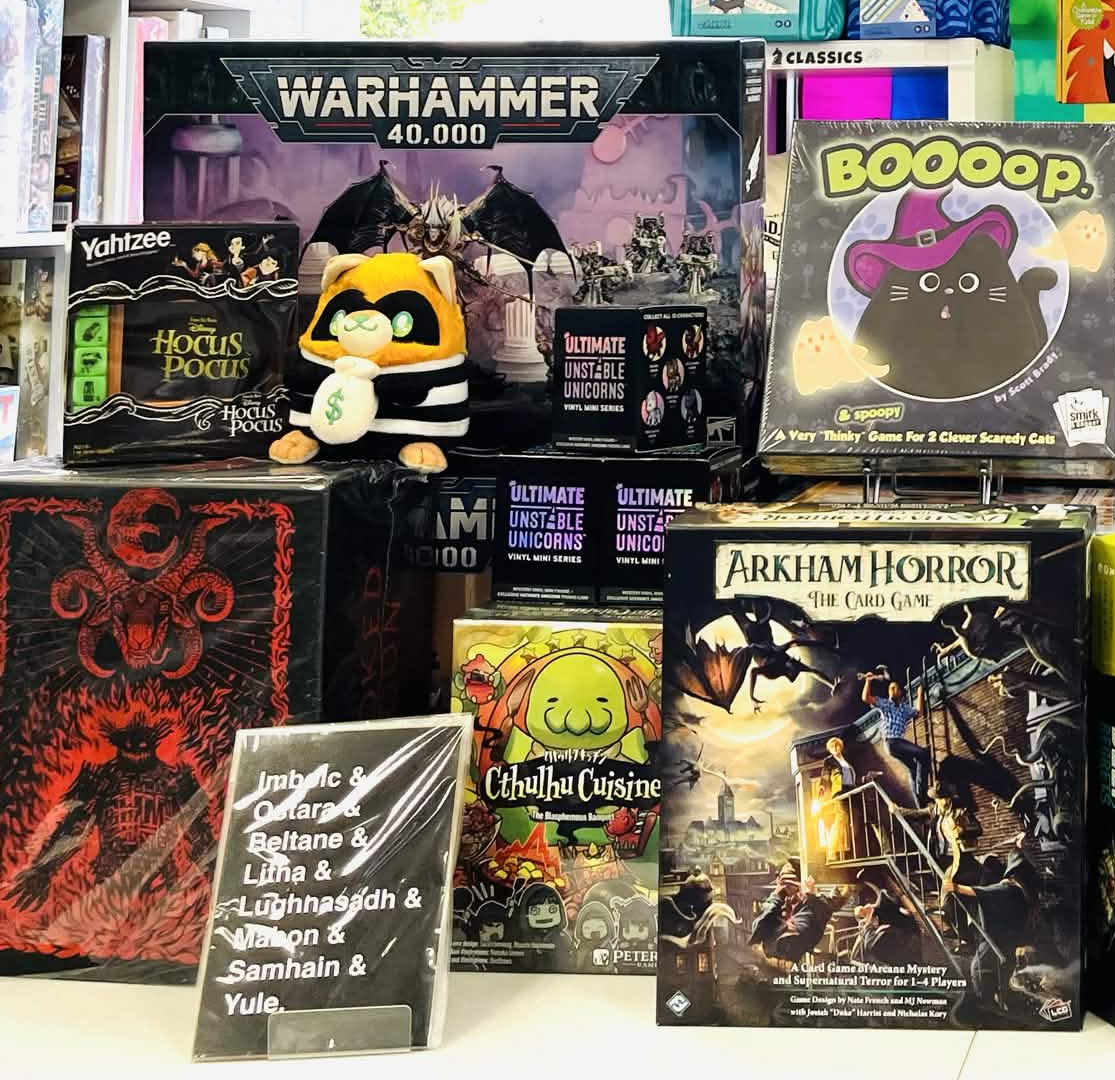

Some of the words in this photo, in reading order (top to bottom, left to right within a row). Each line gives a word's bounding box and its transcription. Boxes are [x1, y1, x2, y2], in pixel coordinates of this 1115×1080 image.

[786, 50, 863, 65] CLASSICS
[276, 76, 600, 119] WARHAMMER
[388, 123, 487, 146] 40,000
[80, 230, 172, 261] Yahtzee
[150, 328, 243, 357] HOCUS
[563, 331, 626, 354] ULTIMATE
[160, 355, 249, 383] POCUS
[564, 358, 625, 380] UNSTABLE
[563, 381, 625, 400] UNICORNS
[1008, 374, 1033, 397] Scott
[218, 404, 276, 420] HOCUS
[854, 405, 902, 423] spoopy
[1069, 408, 1099, 422] smirk
[231, 418, 283, 438] POCUS
[788, 431, 816, 443] Very
[868, 431, 903, 443] Game
[905, 431, 926, 443] For
[928, 431, 937, 443] 2
[939, 431, 976, 443] Clever
[979, 431, 1026, 446] Scaredy
[1028, 432, 1056, 444] Cats
[509, 480, 585, 505] ULTIMATE
[616, 483, 693, 507] ULTIMATE
[508, 506, 584, 530] UNSTABLE
[508, 530, 584, 550] UNICORNS
[724, 549, 863, 589] ARKHAM
[869, 548, 1023, 591] HORROR
[845, 591, 886, 610] CARD
[890, 592, 934, 610] GAME
[257, 768, 342, 792] Imblc
[349, 766, 368, 786] &
[485, 765, 574, 802] Cthulhu
[578, 767, 662, 802] Cuisine
[343, 800, 361, 817] &
[249, 831, 344, 852] Beltane
[351, 827, 369, 848] &
[314, 860, 332, 881] &
[238, 888, 396, 920] Lughnasadh
[404, 887, 422, 908] &
[327, 923, 345, 944] &
[228, 956, 341, 983] Samhain
[349, 954, 367, 976] &
[800, 963, 825, 973] Card
[827, 963, 856, 973] Game
[870, 964, 906, 974] Arcane
[907, 964, 948, 977] Mystery
[773, 975, 791, 986] and
[793, 975, 859, 988] Supernatural
[860, 976, 892, 987] Terror
[893, 976, 909, 987] for
[931, 977, 967, 989] Players
[224, 992, 286, 1015] Yule.
